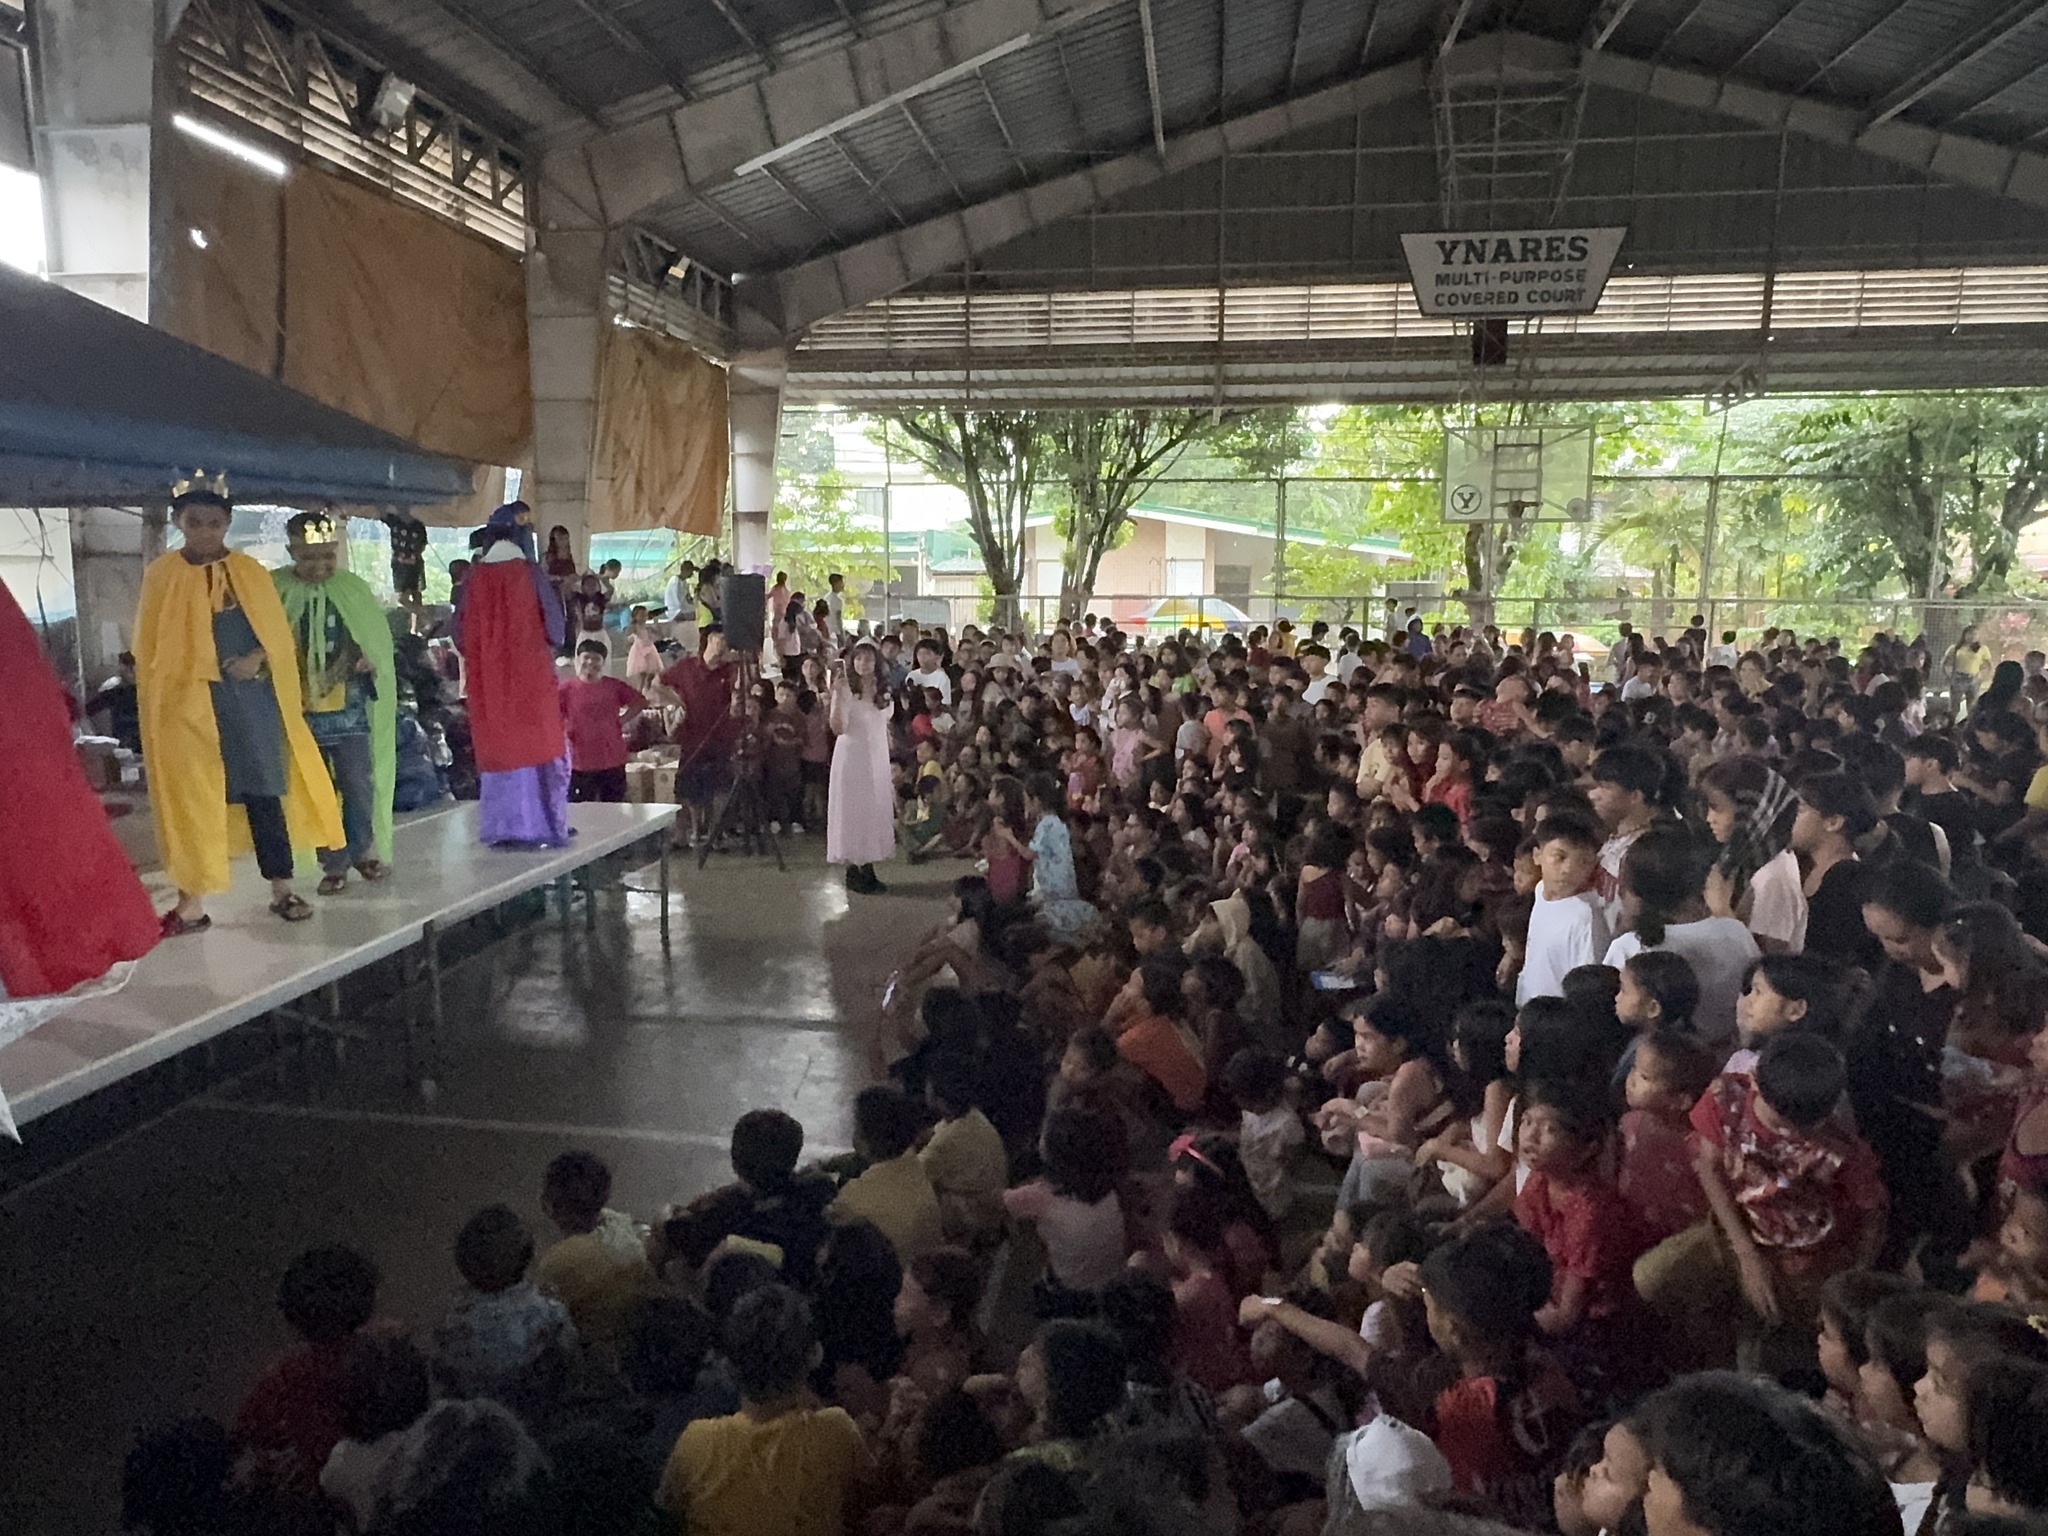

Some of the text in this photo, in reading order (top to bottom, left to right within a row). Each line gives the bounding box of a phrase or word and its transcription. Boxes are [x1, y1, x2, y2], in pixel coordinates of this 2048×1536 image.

[1435, 236, 1589, 265] YNARES
[1435, 289, 1586, 307] COVERED COURT
[1457, 492, 1476, 509] Y
